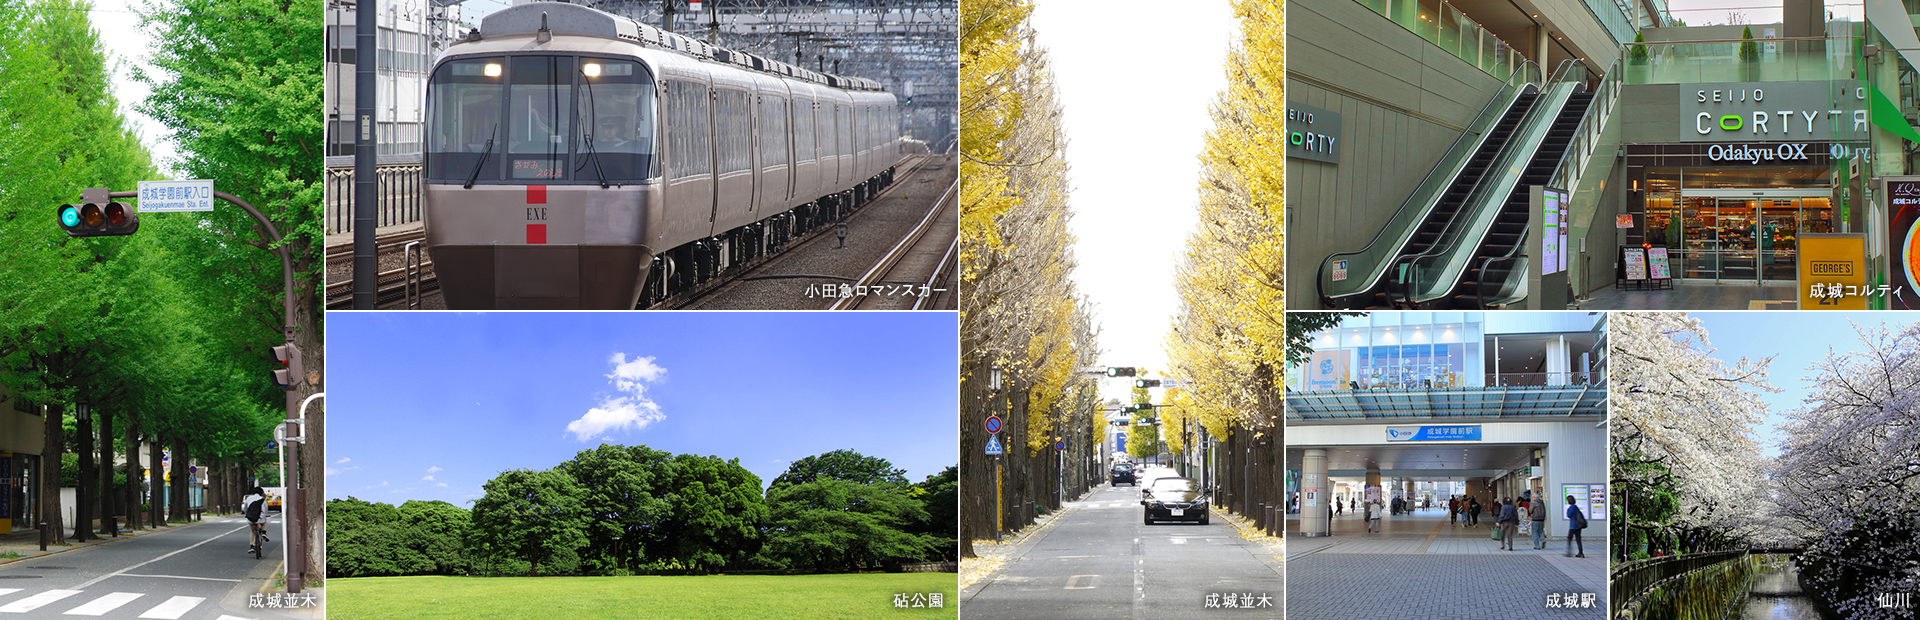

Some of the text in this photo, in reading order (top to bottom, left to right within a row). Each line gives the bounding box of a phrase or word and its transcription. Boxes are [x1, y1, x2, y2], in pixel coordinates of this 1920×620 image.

[1697, 89, 1764, 102] SEIJO
[1286, 108, 1314, 124] EIJO
[1696, 110, 1818, 135] CORTY
[1286, 127, 1336, 154] ORTY
[1708, 144, 1774, 165] Odakyu
[1777, 143, 1808, 160] OX
[142, 186, 209, 200] 成城学園前駅入口
[142, 201, 185, 209] Seijogakuenmae
[187, 200, 197, 208] Sta.
[526, 207, 547, 220] EXE
[1813, 263, 1851, 273] GEORGE'S
